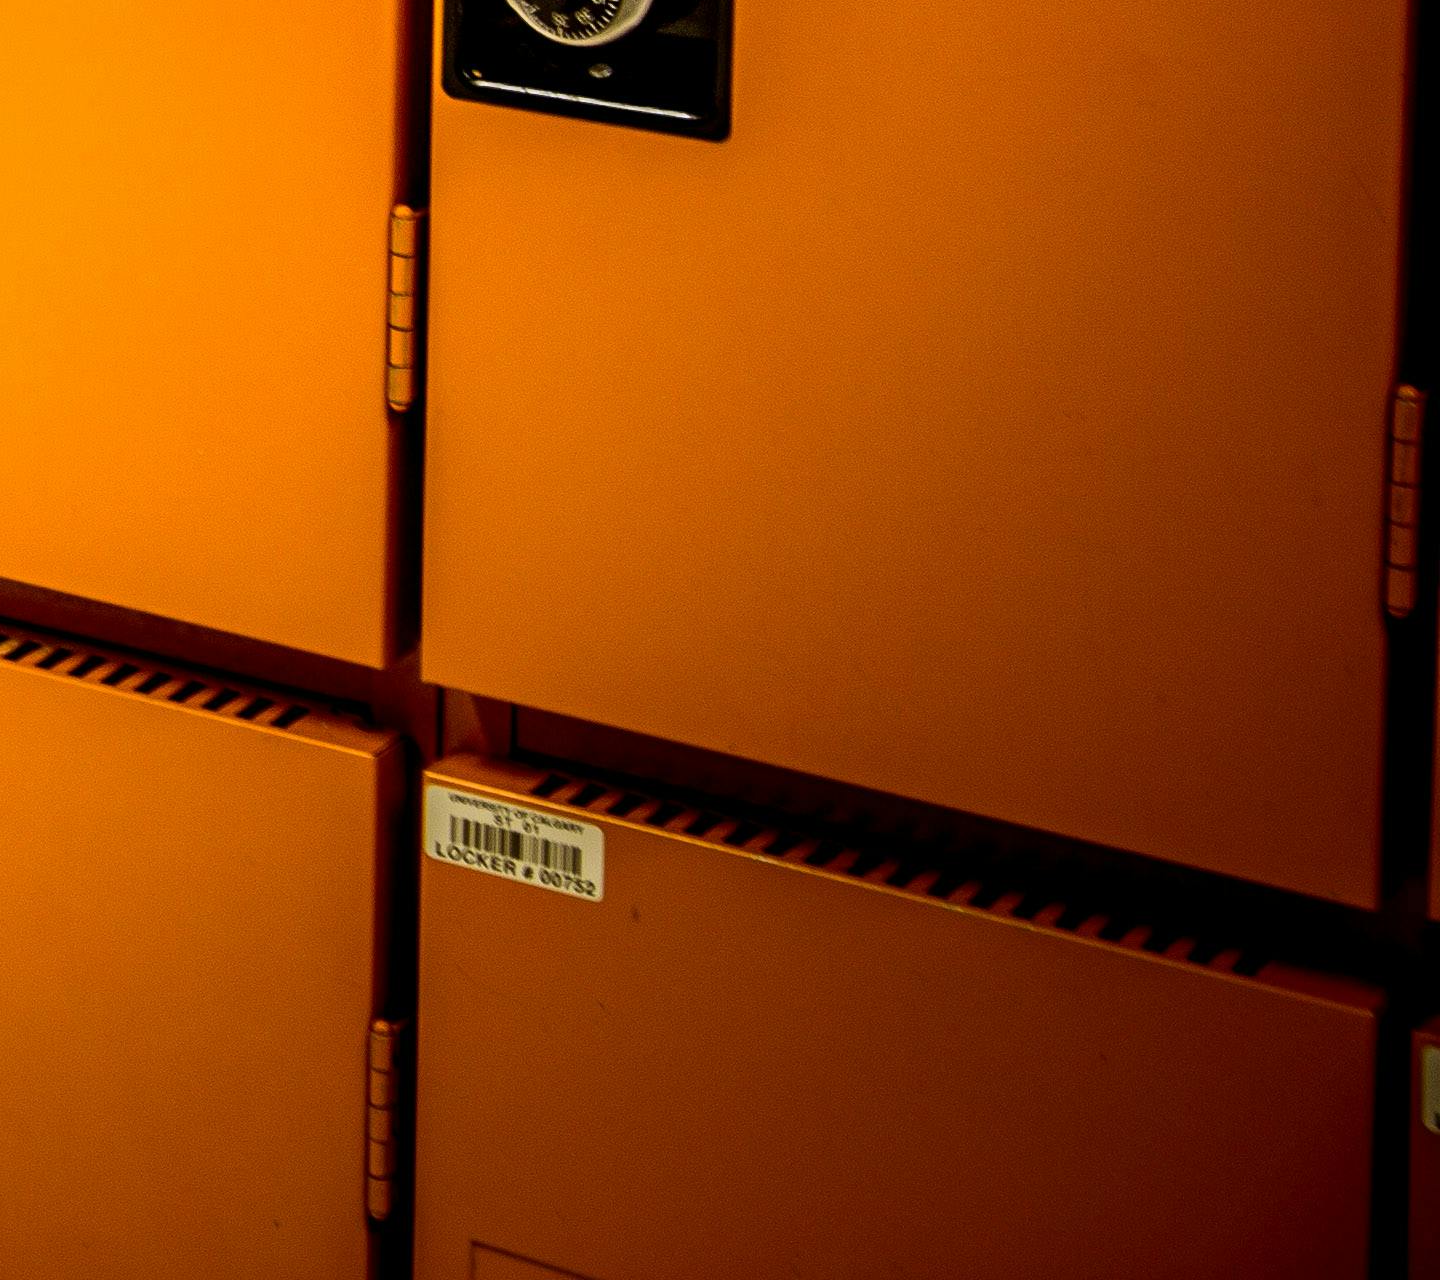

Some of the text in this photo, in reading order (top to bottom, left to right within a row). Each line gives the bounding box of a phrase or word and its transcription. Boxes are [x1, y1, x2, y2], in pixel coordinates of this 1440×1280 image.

[493, 812, 511, 828] ST
[434, 840, 596, 898] LOCKER # 00752
